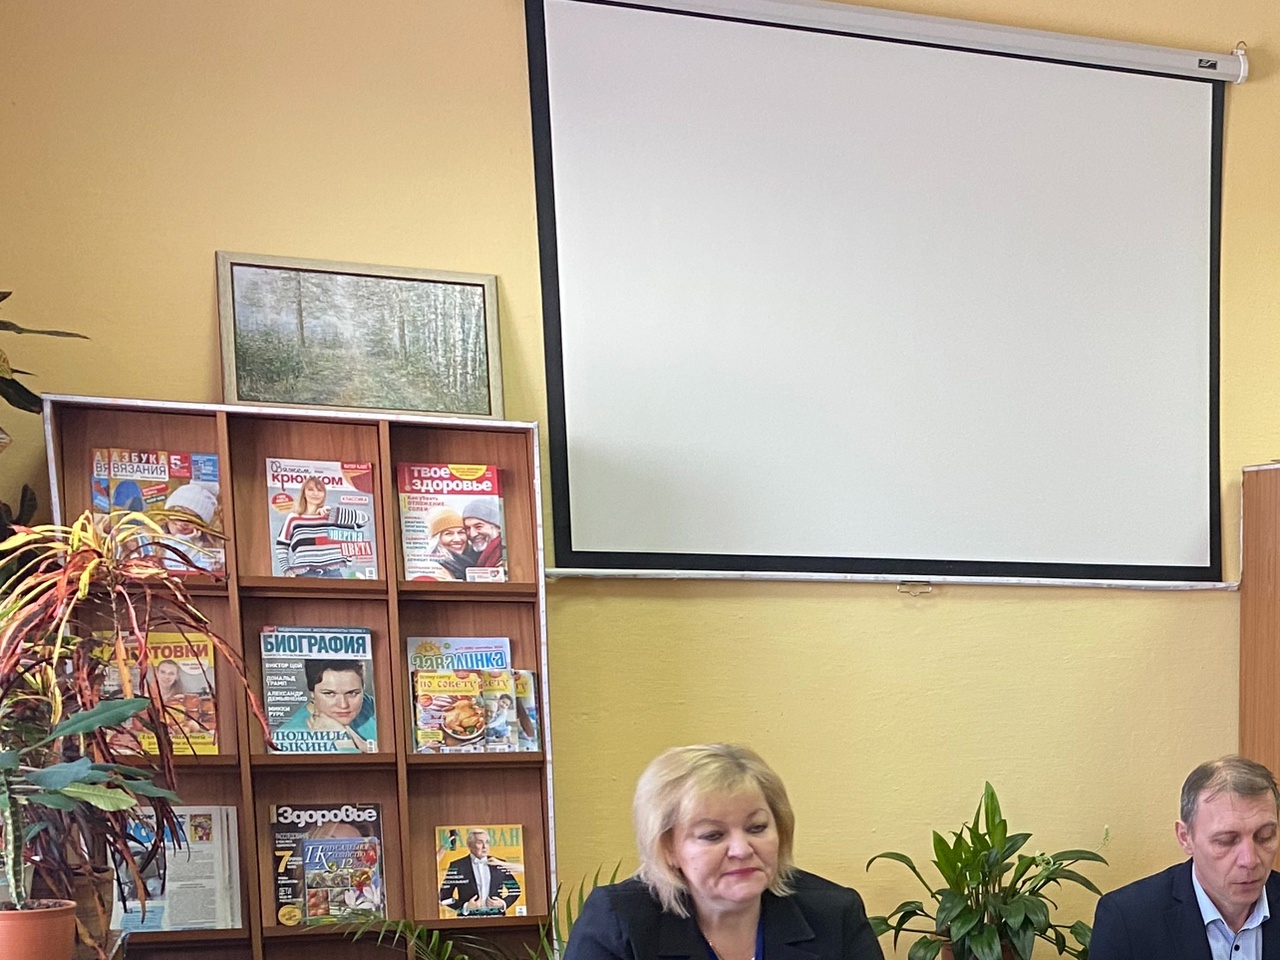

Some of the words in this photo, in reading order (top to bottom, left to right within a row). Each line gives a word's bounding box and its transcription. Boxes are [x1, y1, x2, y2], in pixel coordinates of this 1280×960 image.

[112, 451, 167, 464] АЗБУКА
[112, 463, 167, 476] ВЯЗАНИЯ
[412, 479, 492, 493] здоровье
[341, 542, 372, 556] ЦВЕТА
[263, 634, 367, 654] БИОГРАФИЯ
[278, 805, 377, 827] Здоровье
